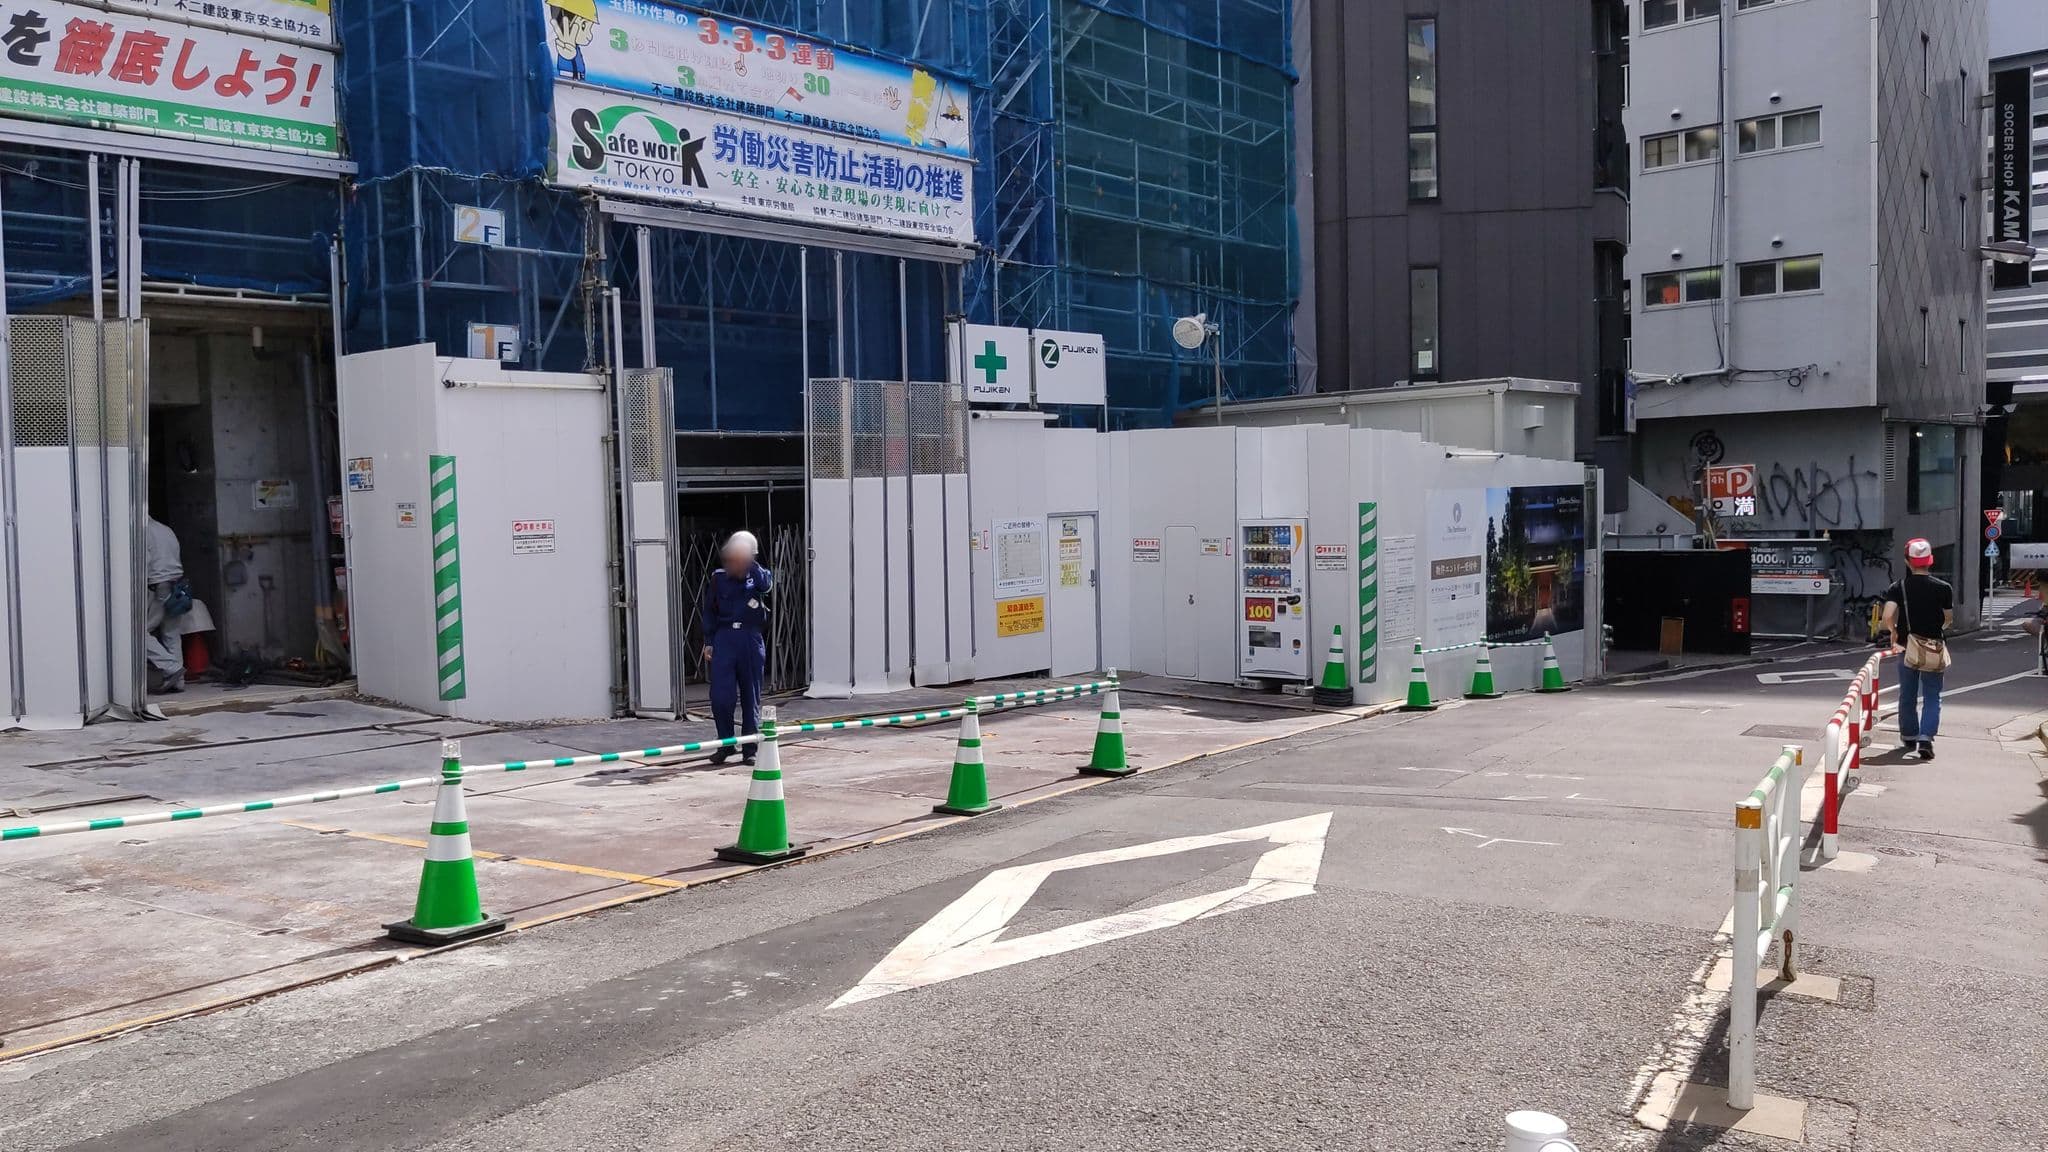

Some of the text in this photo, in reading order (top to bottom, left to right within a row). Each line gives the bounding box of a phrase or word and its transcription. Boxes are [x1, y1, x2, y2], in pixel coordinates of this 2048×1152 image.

[804, 72, 831, 96] 30
[174, 111, 327, 146] 不二建設東京安全協力会
[614, 160, 675, 184] TOKYO
[712, 123, 964, 202] 労働災害防止活動の推進
[2003, 103, 2021, 241] SOCCER SHOP KAM
[623, 180, 650, 191] Work
[460, 208, 501, 243] 2F
[1062, 344, 1098, 354] FUJIKEN
[973, 386, 1011, 394] FUJIKEN
[1727, 468, 1754, 496] P
[1735, 497, 1755, 516] 満
[1249, 605, 1272, 619] 100
